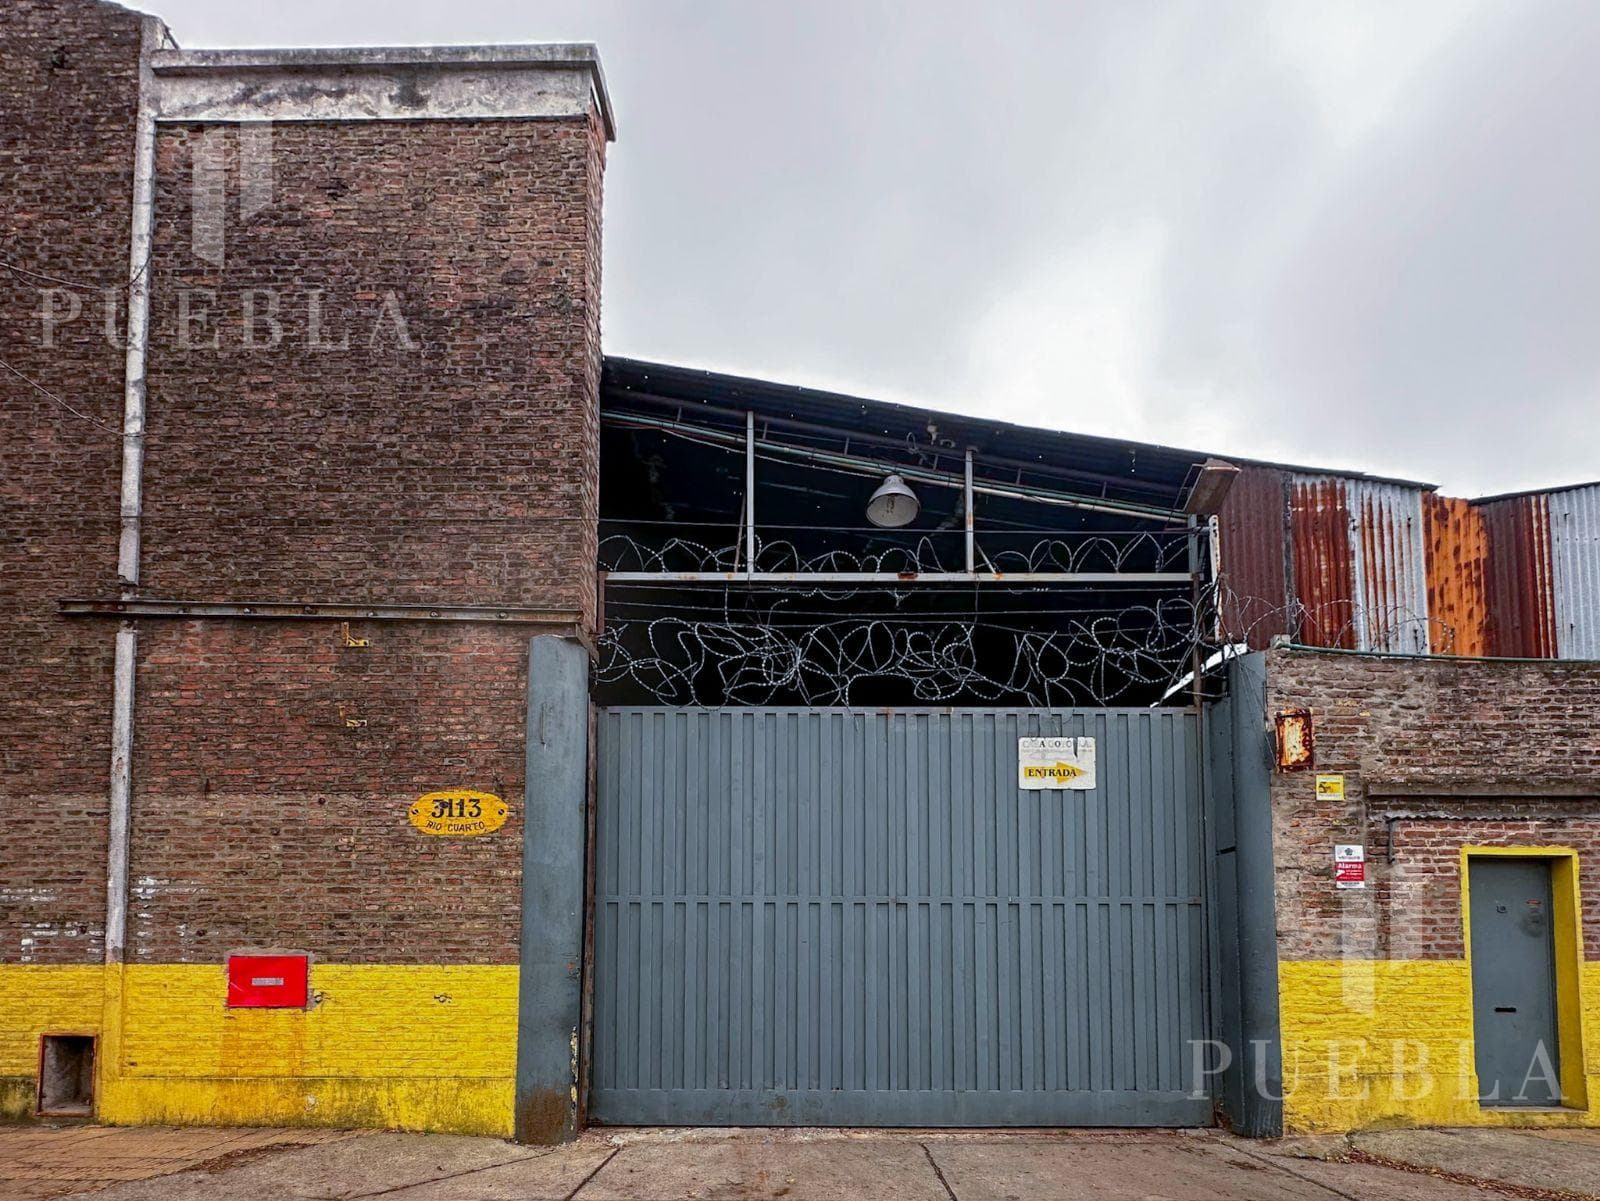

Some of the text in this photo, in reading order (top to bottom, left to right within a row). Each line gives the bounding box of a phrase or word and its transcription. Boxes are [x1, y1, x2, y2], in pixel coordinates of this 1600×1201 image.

[1028, 768, 1077, 777] ENTRADA
[431, 798, 482, 818] 3113
[426, 819, 486, 832] RIO CUARTO
